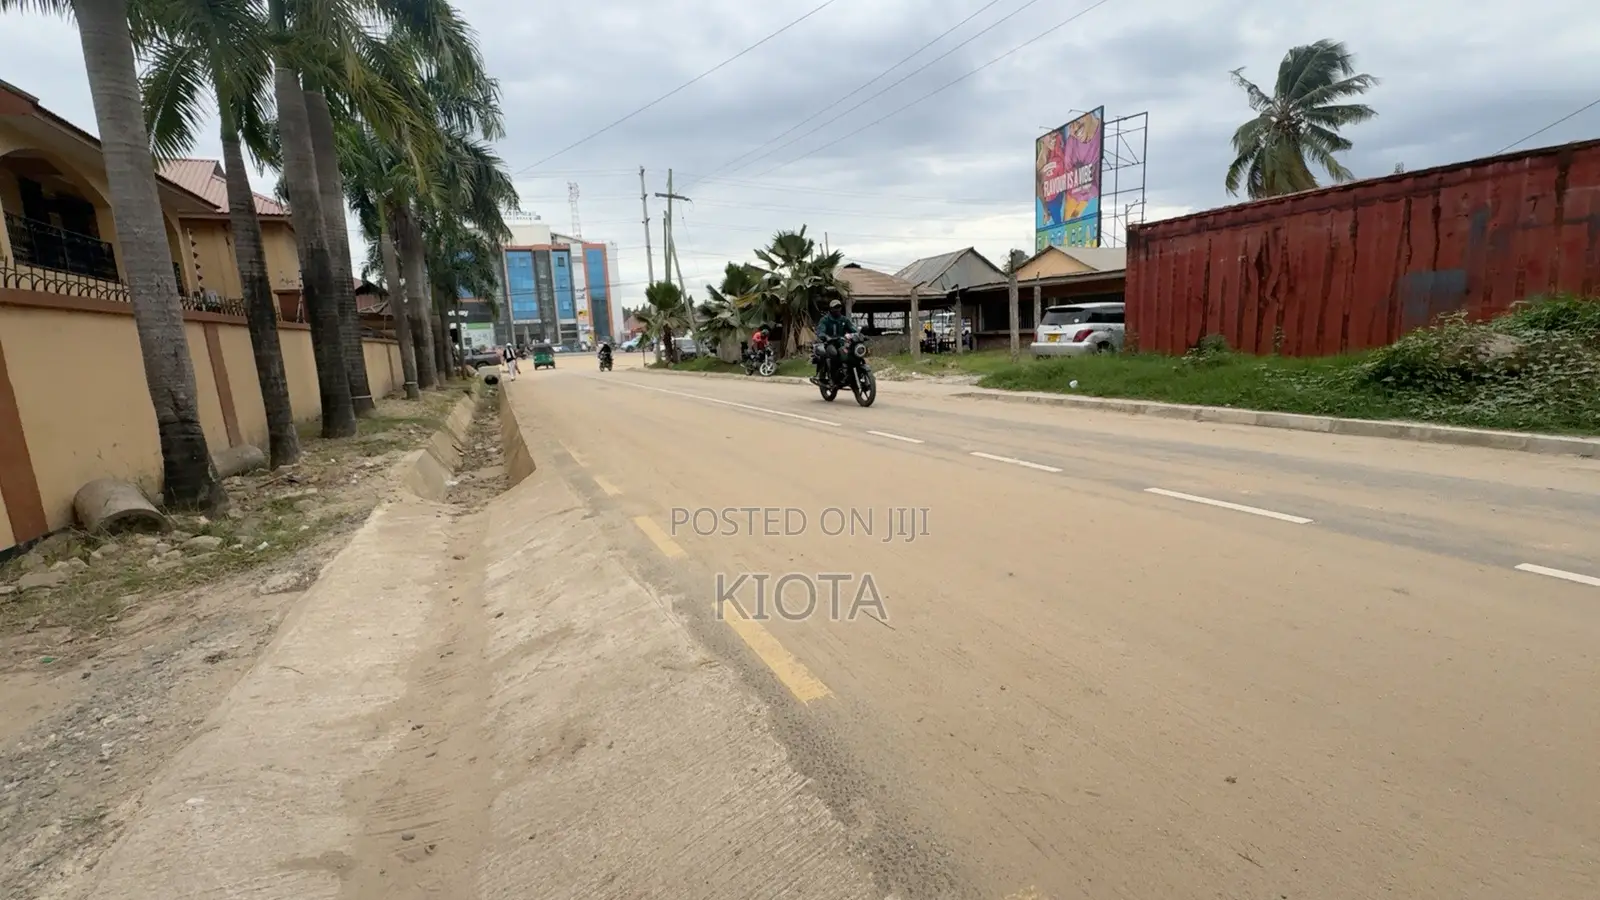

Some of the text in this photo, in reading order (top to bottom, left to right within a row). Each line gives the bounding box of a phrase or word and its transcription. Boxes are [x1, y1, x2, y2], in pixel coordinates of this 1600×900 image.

[1043, 173, 1066, 198] FLAVOUR
[1067, 171, 1074, 189] IS
[1074, 168, 1079, 188] A
[1078, 163, 1093, 185] VIBE
